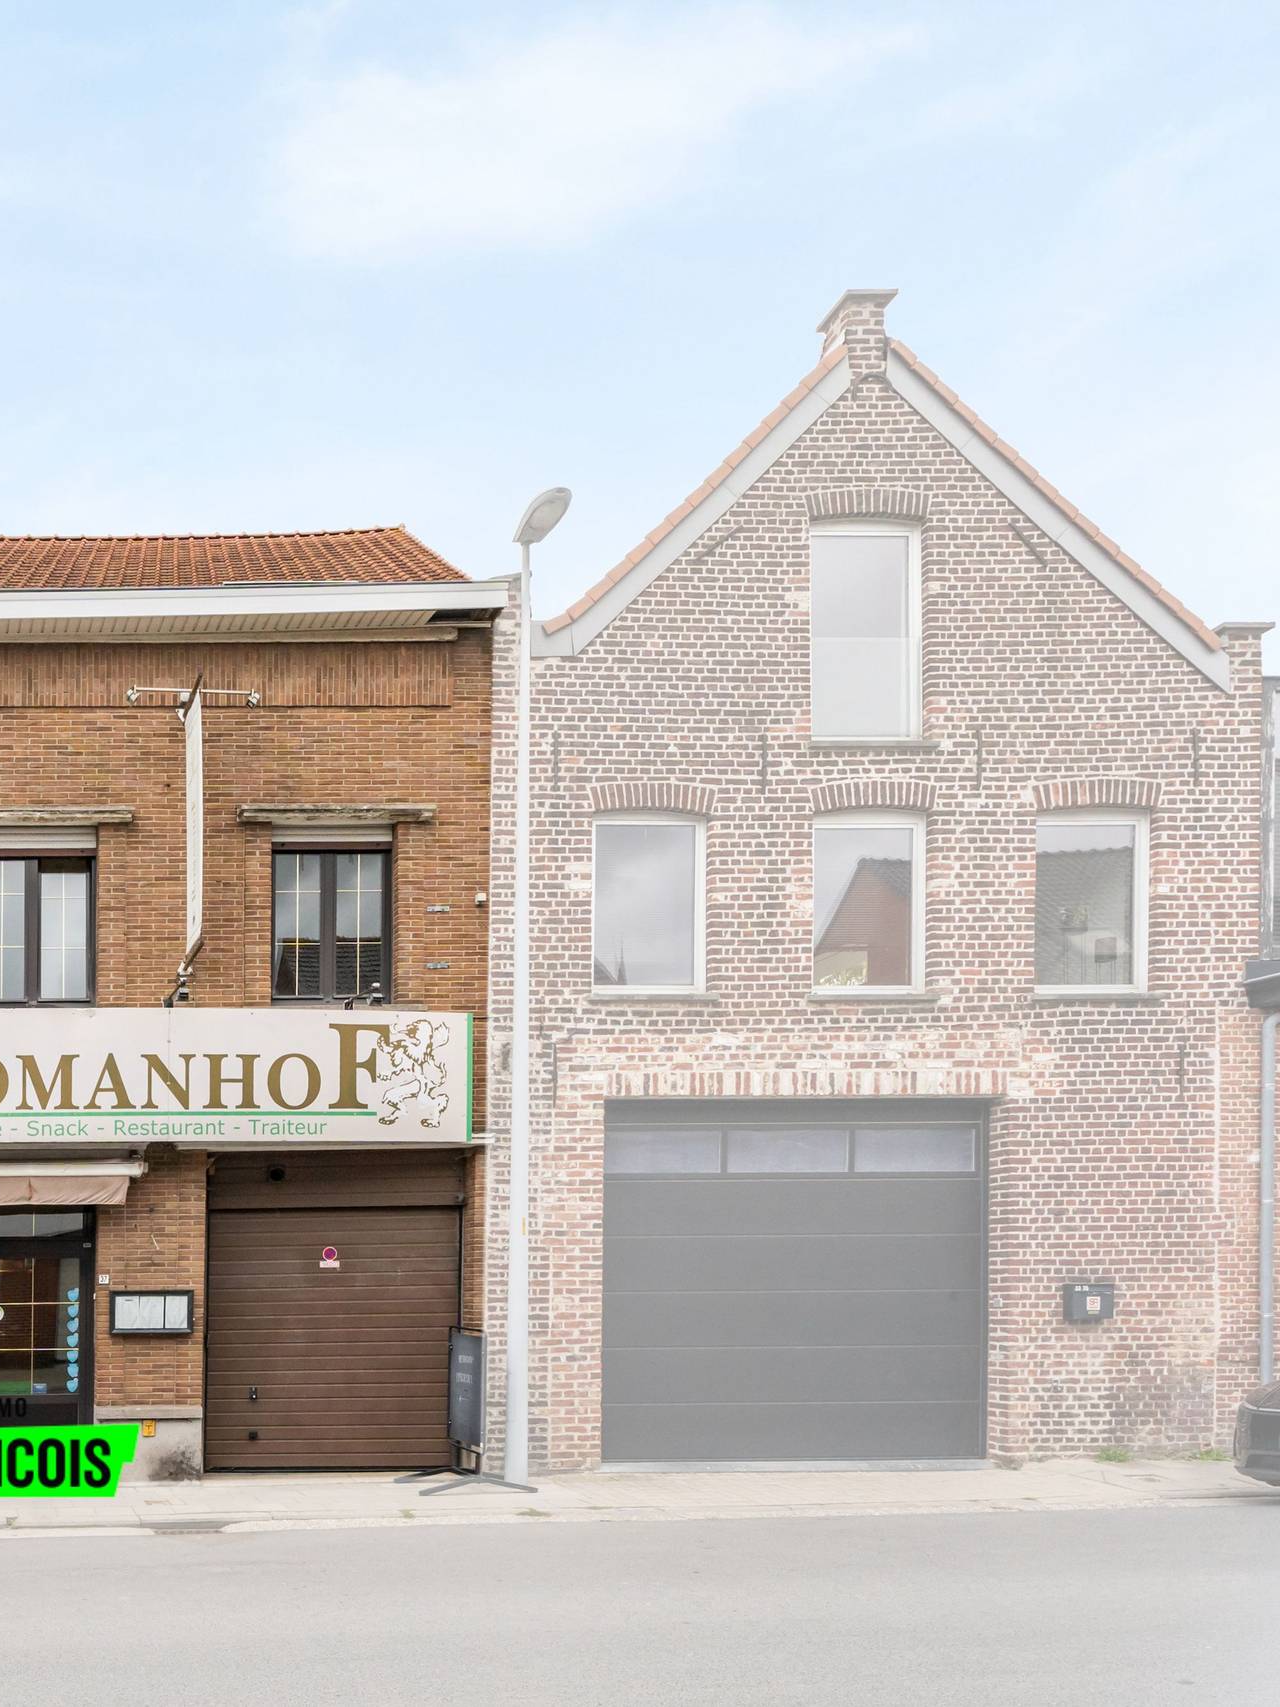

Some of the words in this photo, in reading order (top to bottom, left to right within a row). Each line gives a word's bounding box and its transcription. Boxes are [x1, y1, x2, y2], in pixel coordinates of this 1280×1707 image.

[27, 1119, 89, 1137] Snack
[113, 1119, 225, 1136] Restaurant
[248, 1119, 328, 1136] Traiteur
